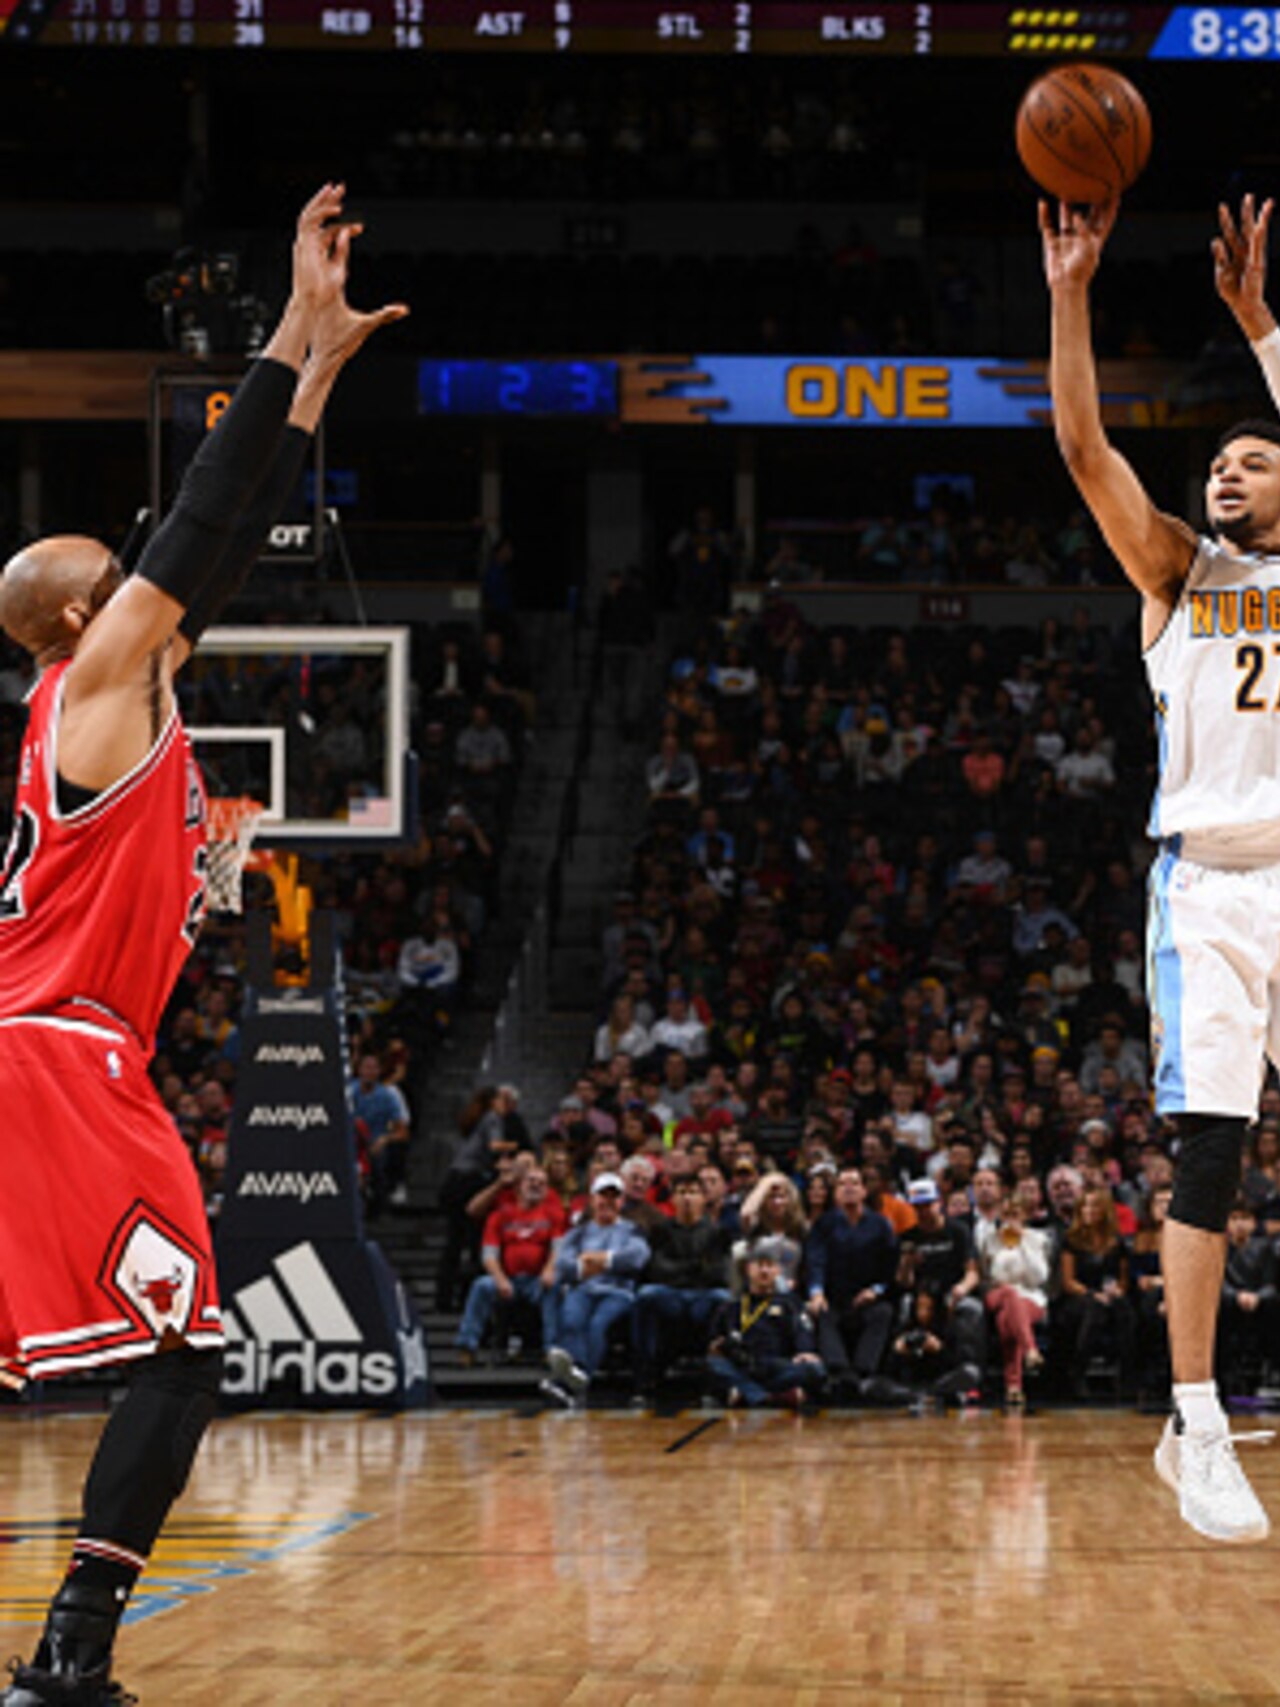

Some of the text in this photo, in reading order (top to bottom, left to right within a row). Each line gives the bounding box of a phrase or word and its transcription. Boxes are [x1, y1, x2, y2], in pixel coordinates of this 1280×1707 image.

[322, 9, 371, 33] REB
[475, 12, 524, 35] AST
[657, 14, 702, 38] STL
[734, 3, 750, 26] 2
[915, 3, 931, 27] 2
[821, 15, 885, 40] BLKS
[734, 28, 750, 52] 2
[915, 29, 931, 53] 2
[787, 365, 949, 419] ONE
[255, 1044, 325, 1068] AVAYA
[248, 1103, 330, 1131] AVAYA
[237, 1170, 339, 1203] AVAYA
[220, 1339, 398, 1394] didas
